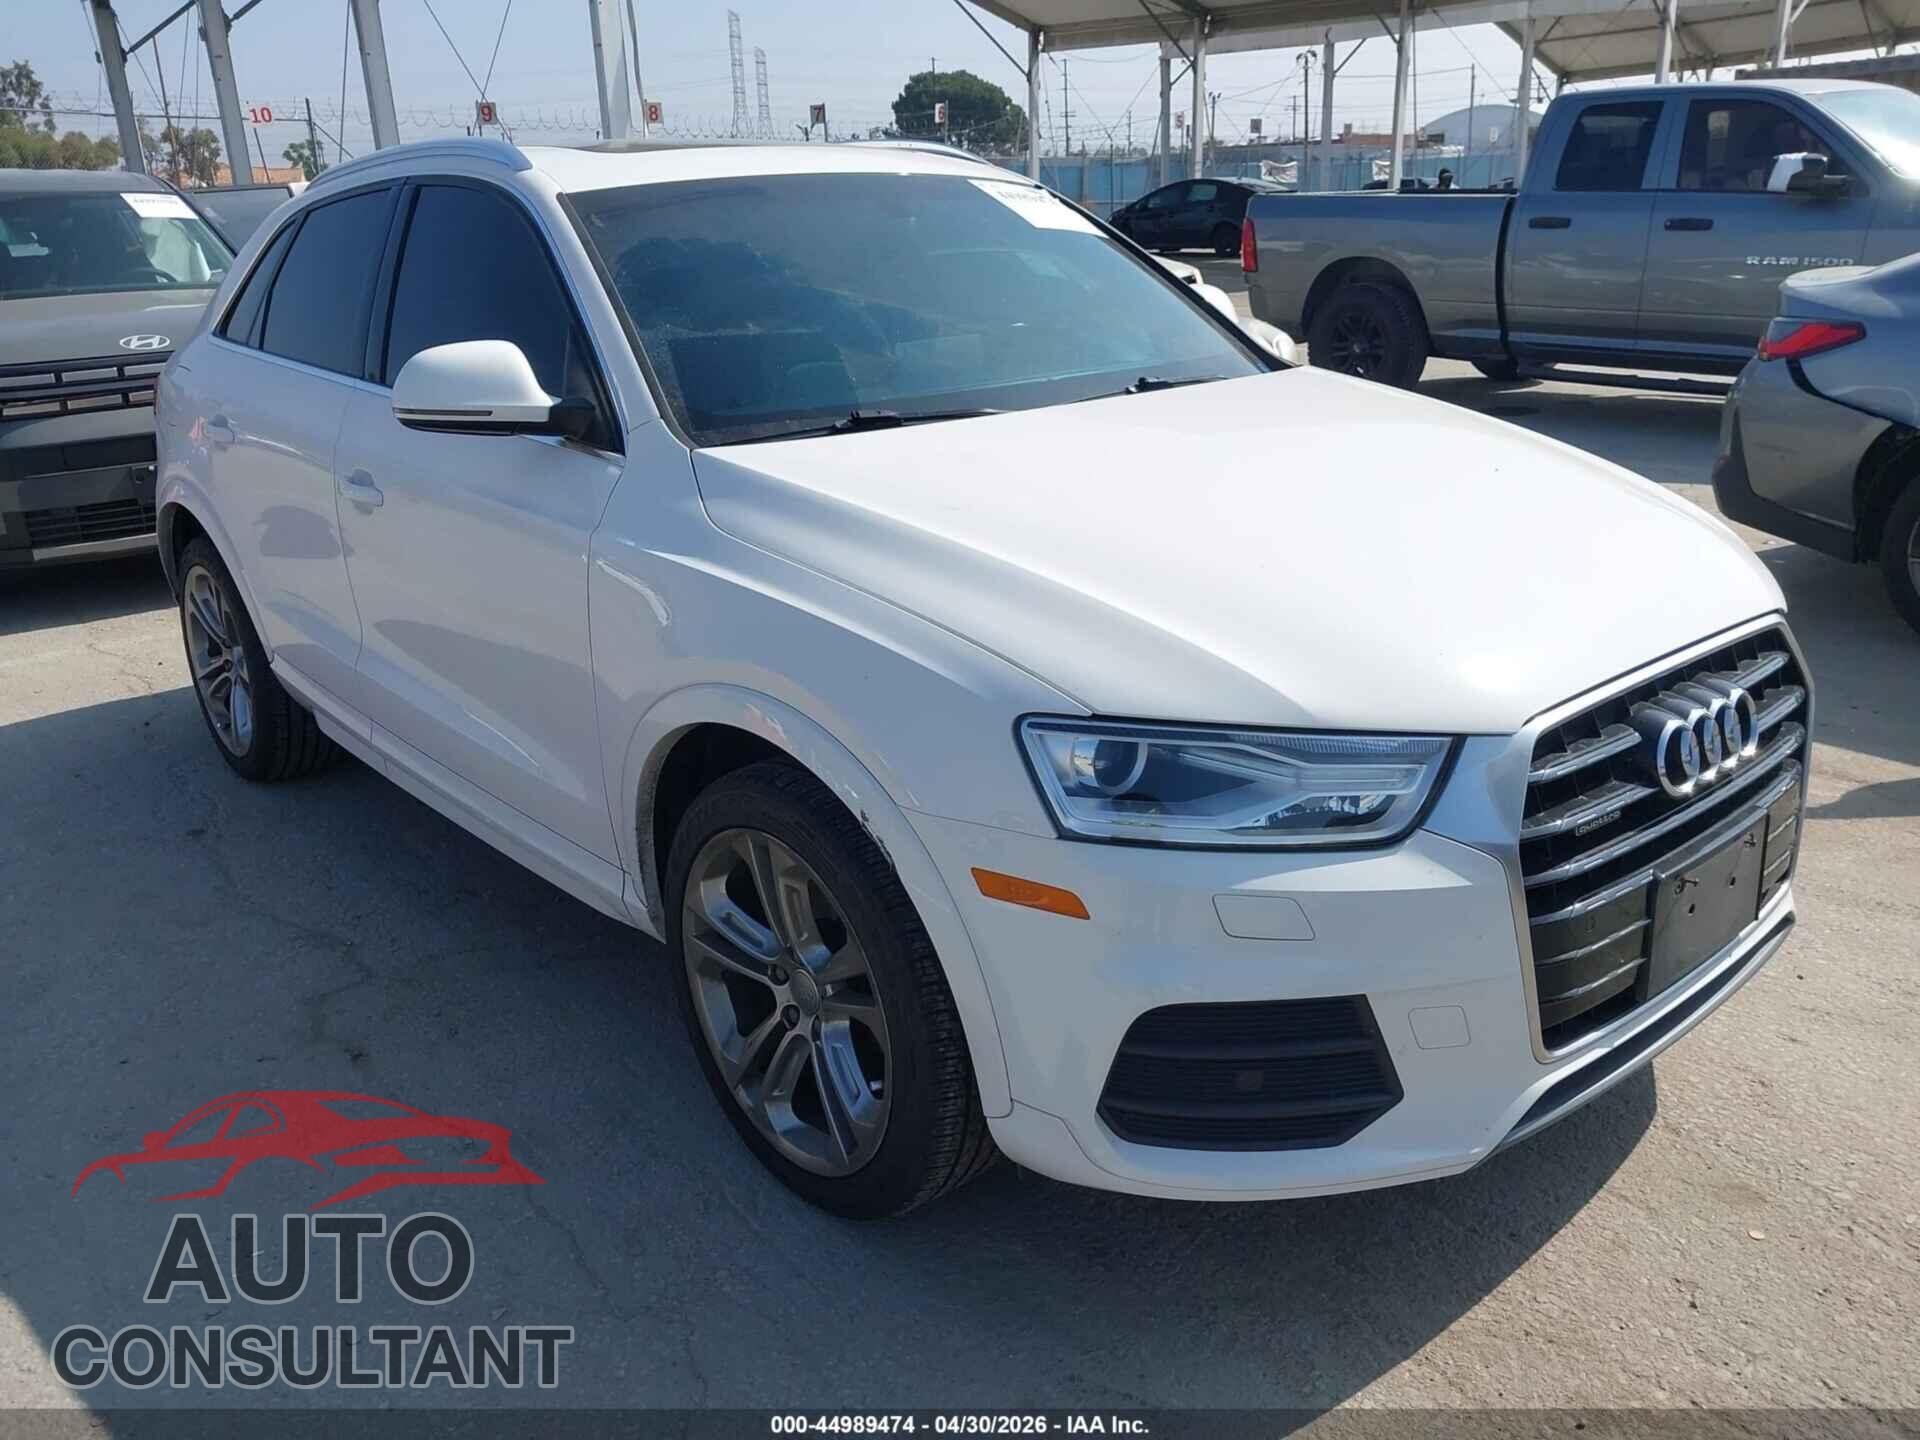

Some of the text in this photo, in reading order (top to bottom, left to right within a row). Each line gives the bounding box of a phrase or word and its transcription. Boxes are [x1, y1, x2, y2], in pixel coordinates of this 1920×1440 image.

[249, 106, 273, 124] 10
[480, 105, 492, 122] 9
[648, 105, 659, 121] 8
[813, 106, 822, 122] 7
[1745, 255, 1855, 266] RAM 1500
